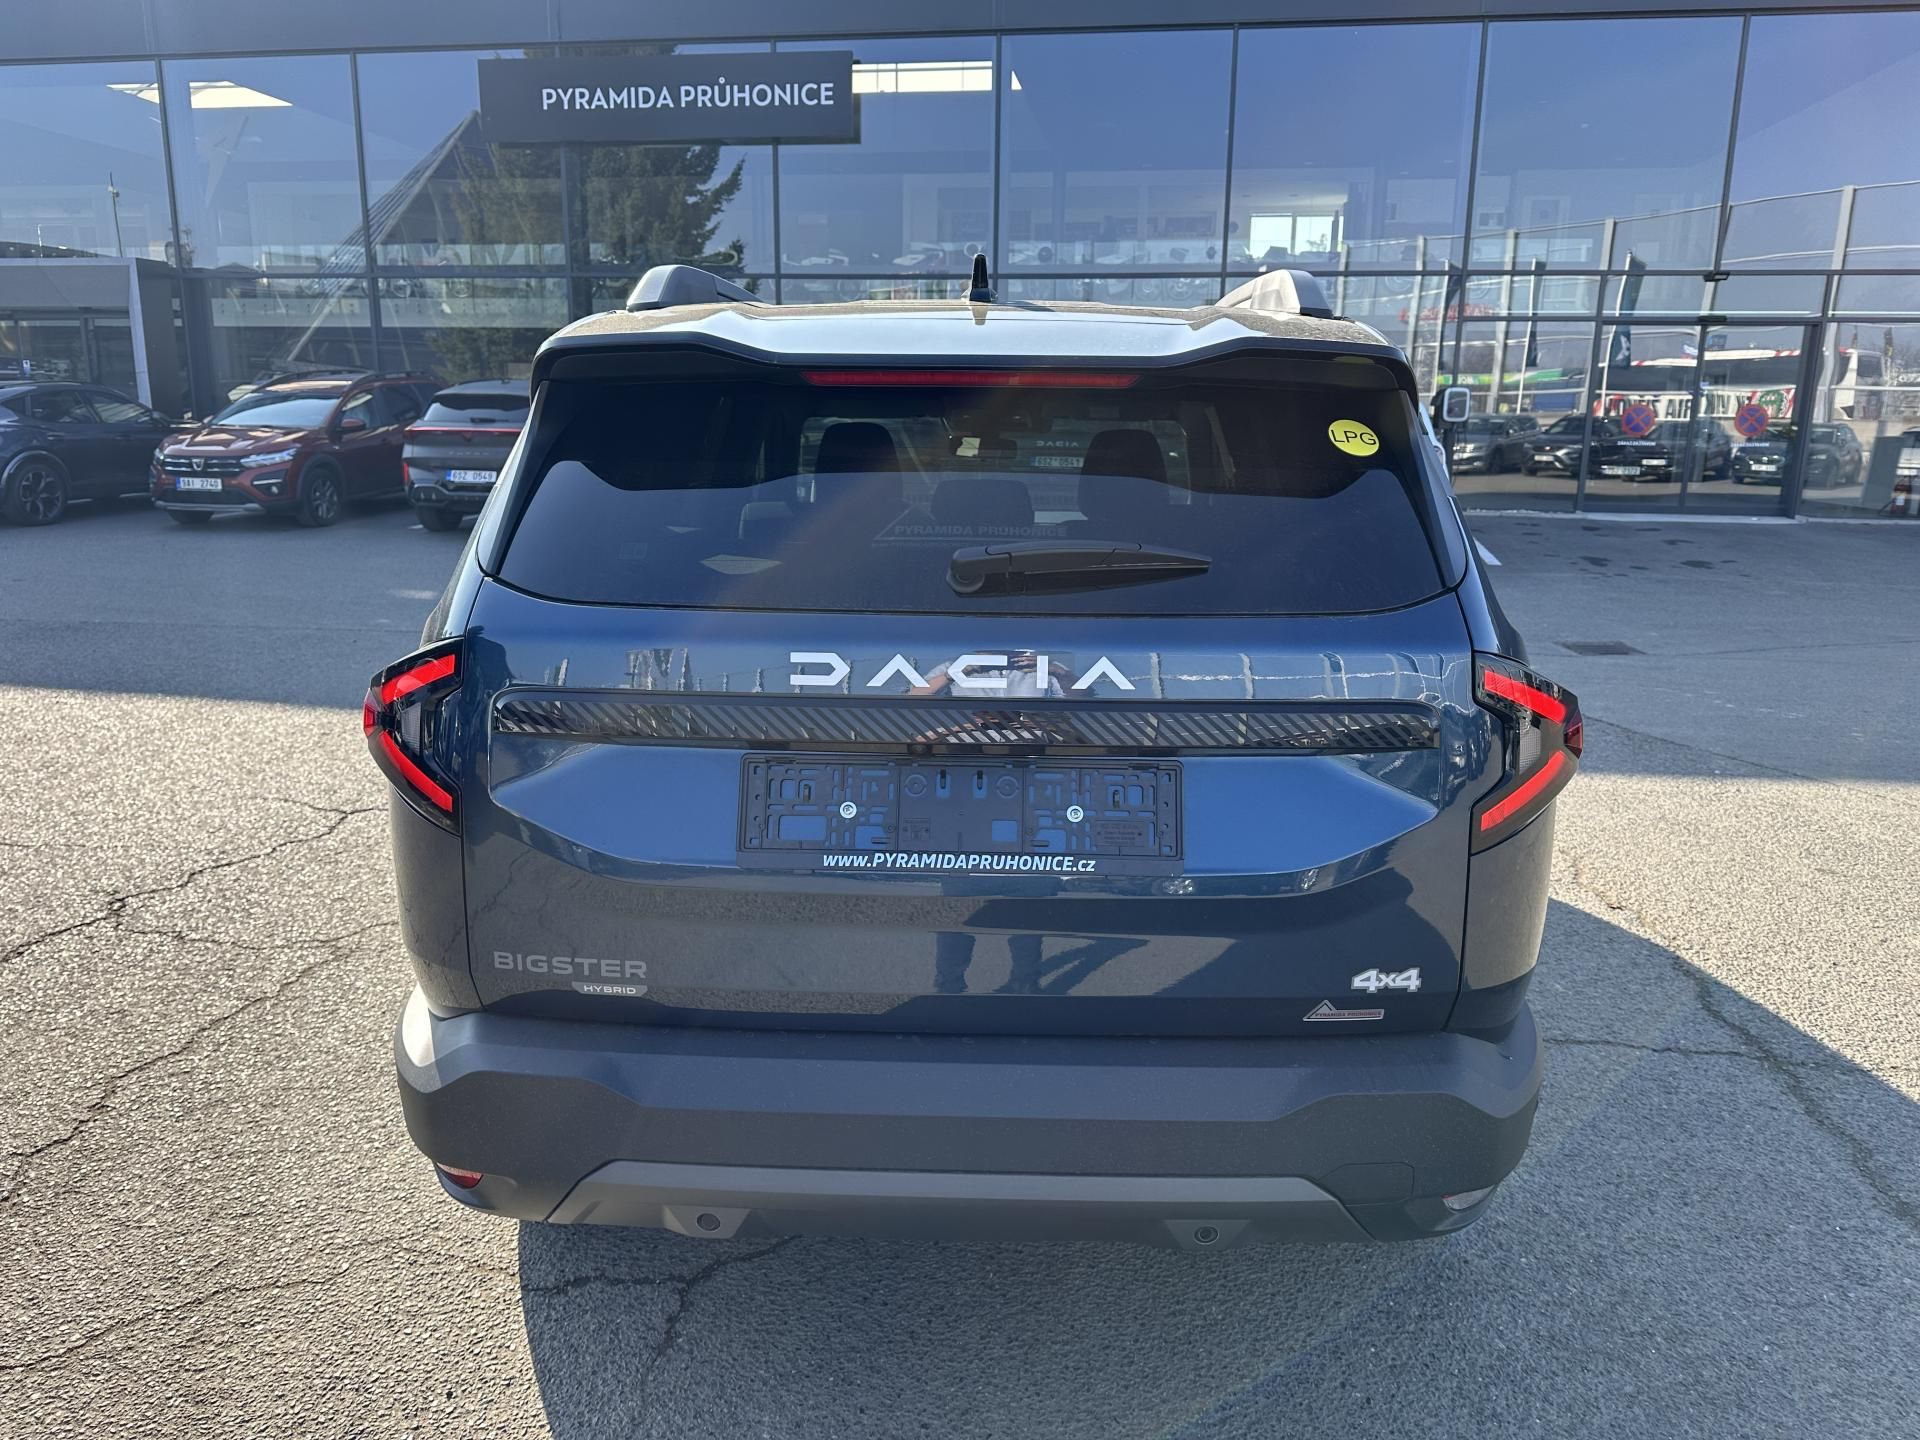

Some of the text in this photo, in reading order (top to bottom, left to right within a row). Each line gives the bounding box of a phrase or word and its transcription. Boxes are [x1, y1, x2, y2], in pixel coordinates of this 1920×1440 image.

[541, 76, 835, 110] PYRAMIDA PRŮHONICE
[1035, 440, 1080, 448] DACIA
[1330, 429, 1377, 446] LPG
[894, 525, 974, 536] PYRAMIDA
[790, 652, 1136, 690] DACIA
[823, 852, 1096, 872] www.PYRAMIDAPRUHONICE.cz
[493, 951, 648, 979] BIGSTER
[583, 985, 637, 994] HYBRID
[1352, 968, 1421, 992] 4x4
